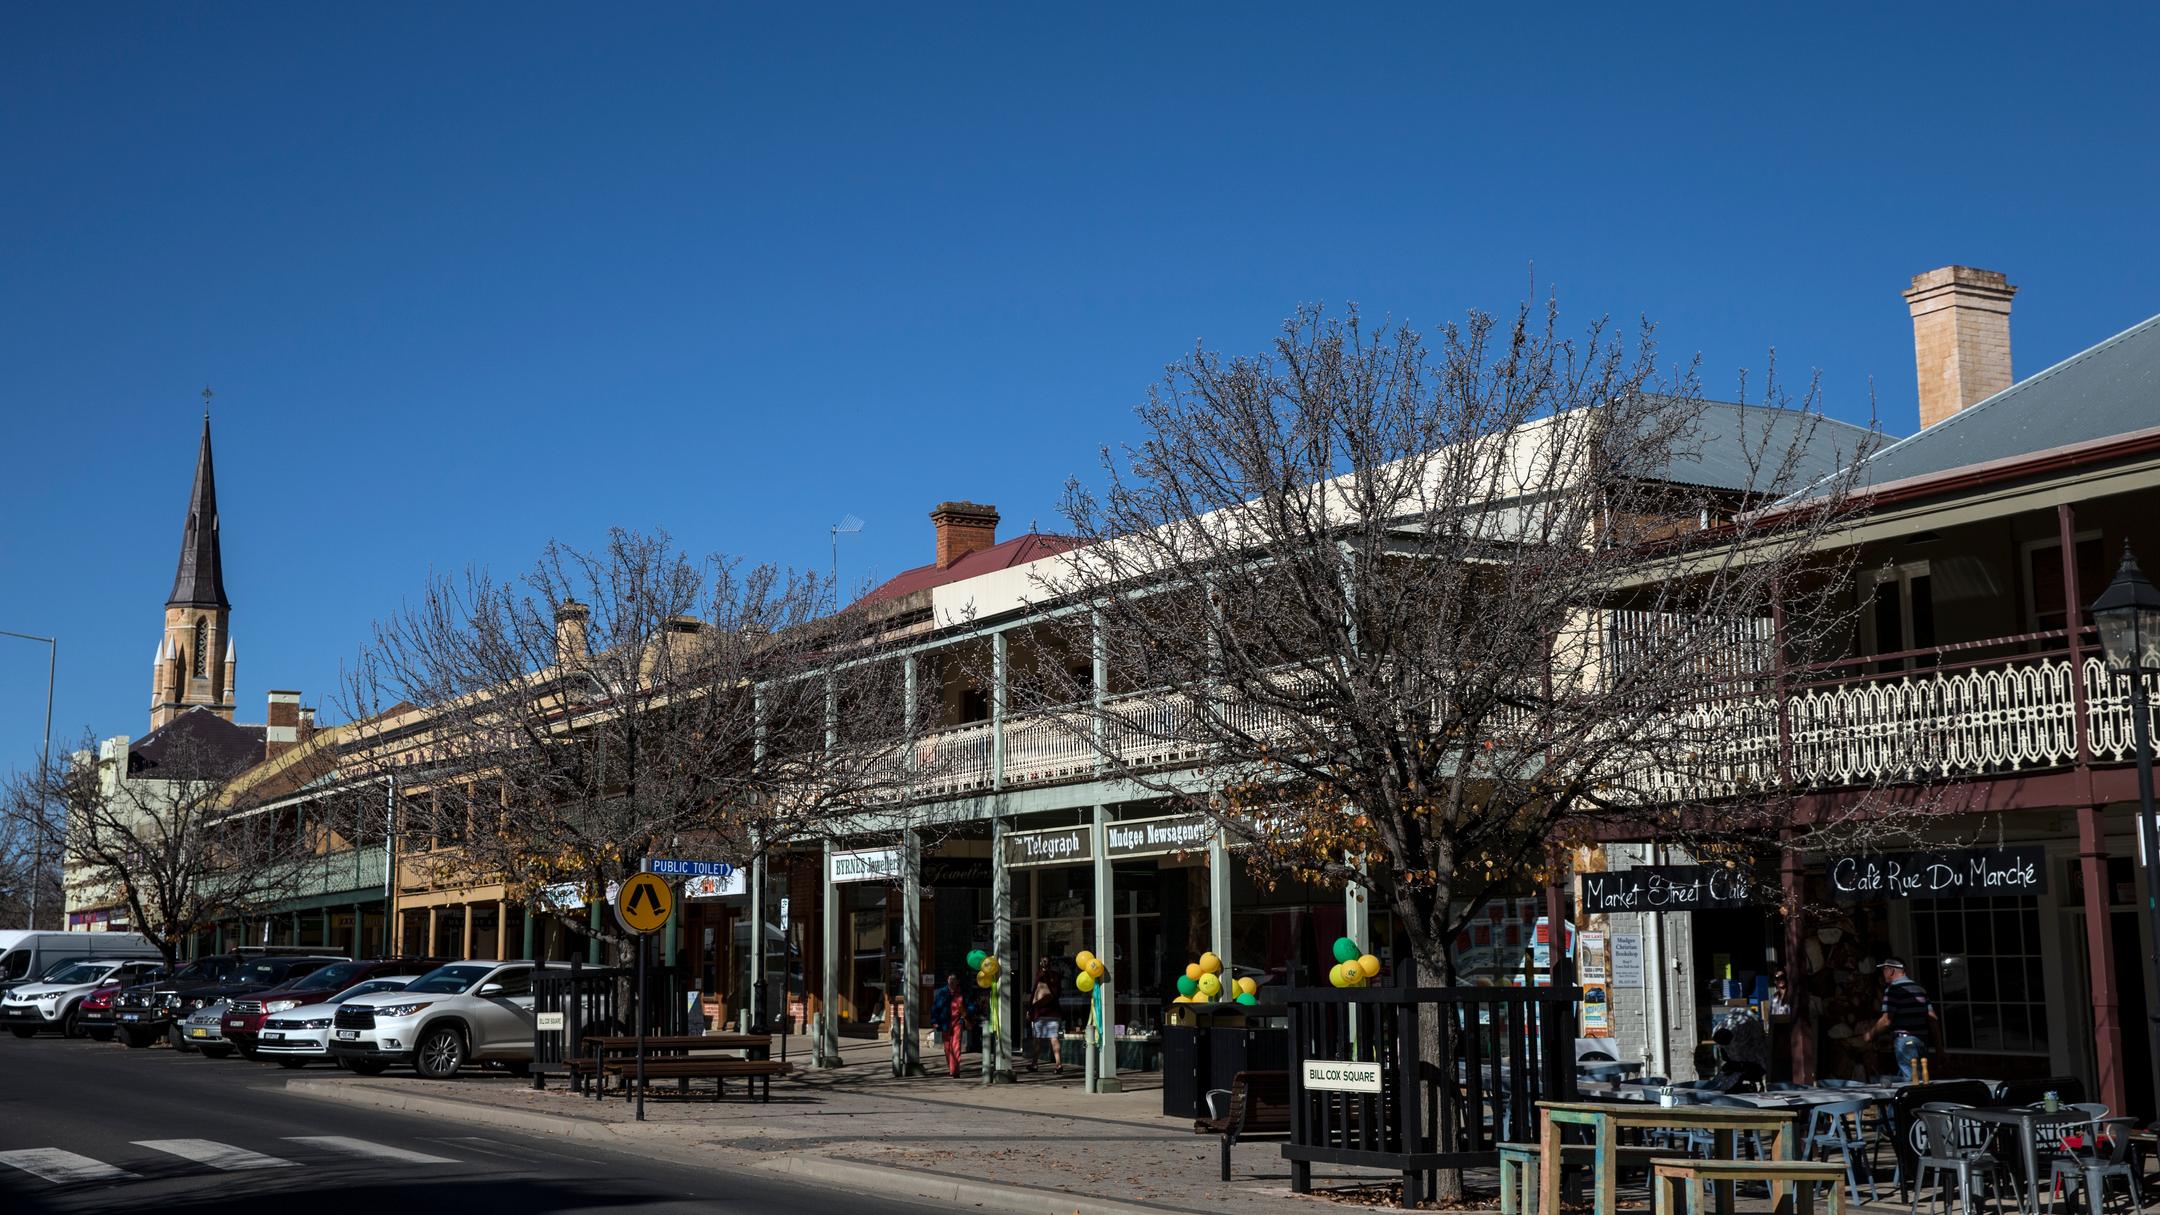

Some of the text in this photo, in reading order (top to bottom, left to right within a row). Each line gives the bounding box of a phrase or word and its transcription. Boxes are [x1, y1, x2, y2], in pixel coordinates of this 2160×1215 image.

[1024, 831, 1079, 858] Telegraph
[1109, 824, 1205, 849] Mudgee Newsagency
[654, 860, 725, 875] PUBLIC TOILET
[836, 856, 901, 875] BYRNES Jewellers
[1834, 856, 2036, 896] Café Rue Du Marché
[1587, 878, 1643, 909] Market
[1648, 874, 1703, 906] Street
[1309, 1069, 1375, 1083] BILL COX SQUARE
